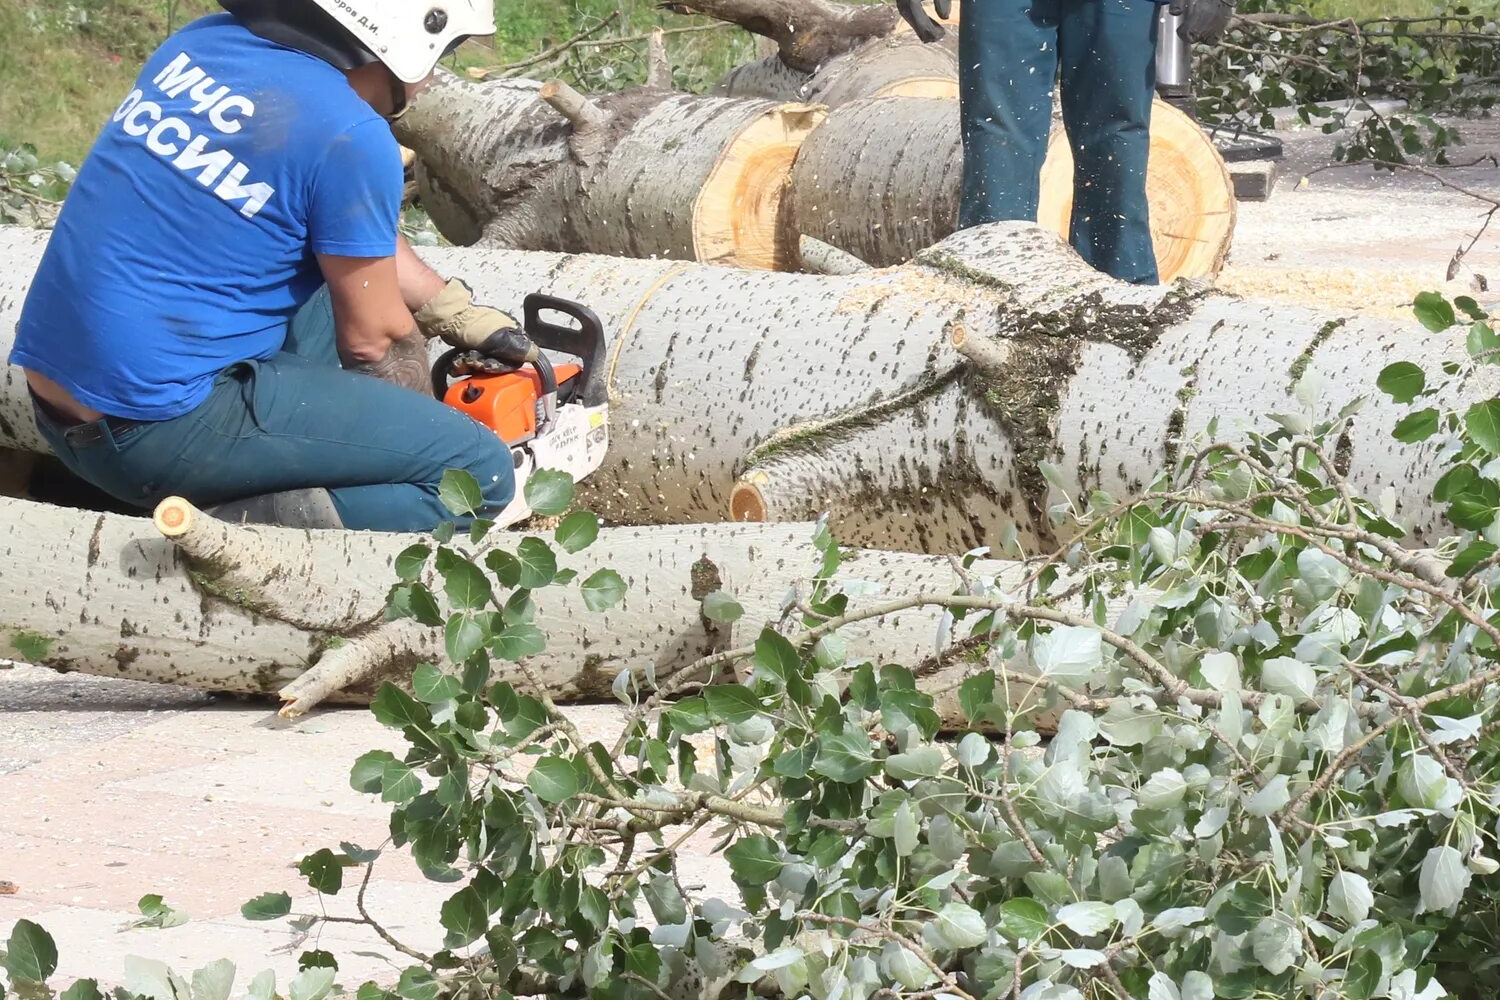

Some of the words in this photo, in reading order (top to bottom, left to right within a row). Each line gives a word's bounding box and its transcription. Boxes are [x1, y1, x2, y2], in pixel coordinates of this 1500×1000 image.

[357, 16, 380, 37] Д.И.
[152, 51, 255, 134] МЧС
[112, 88, 276, 218] ОССИИ
